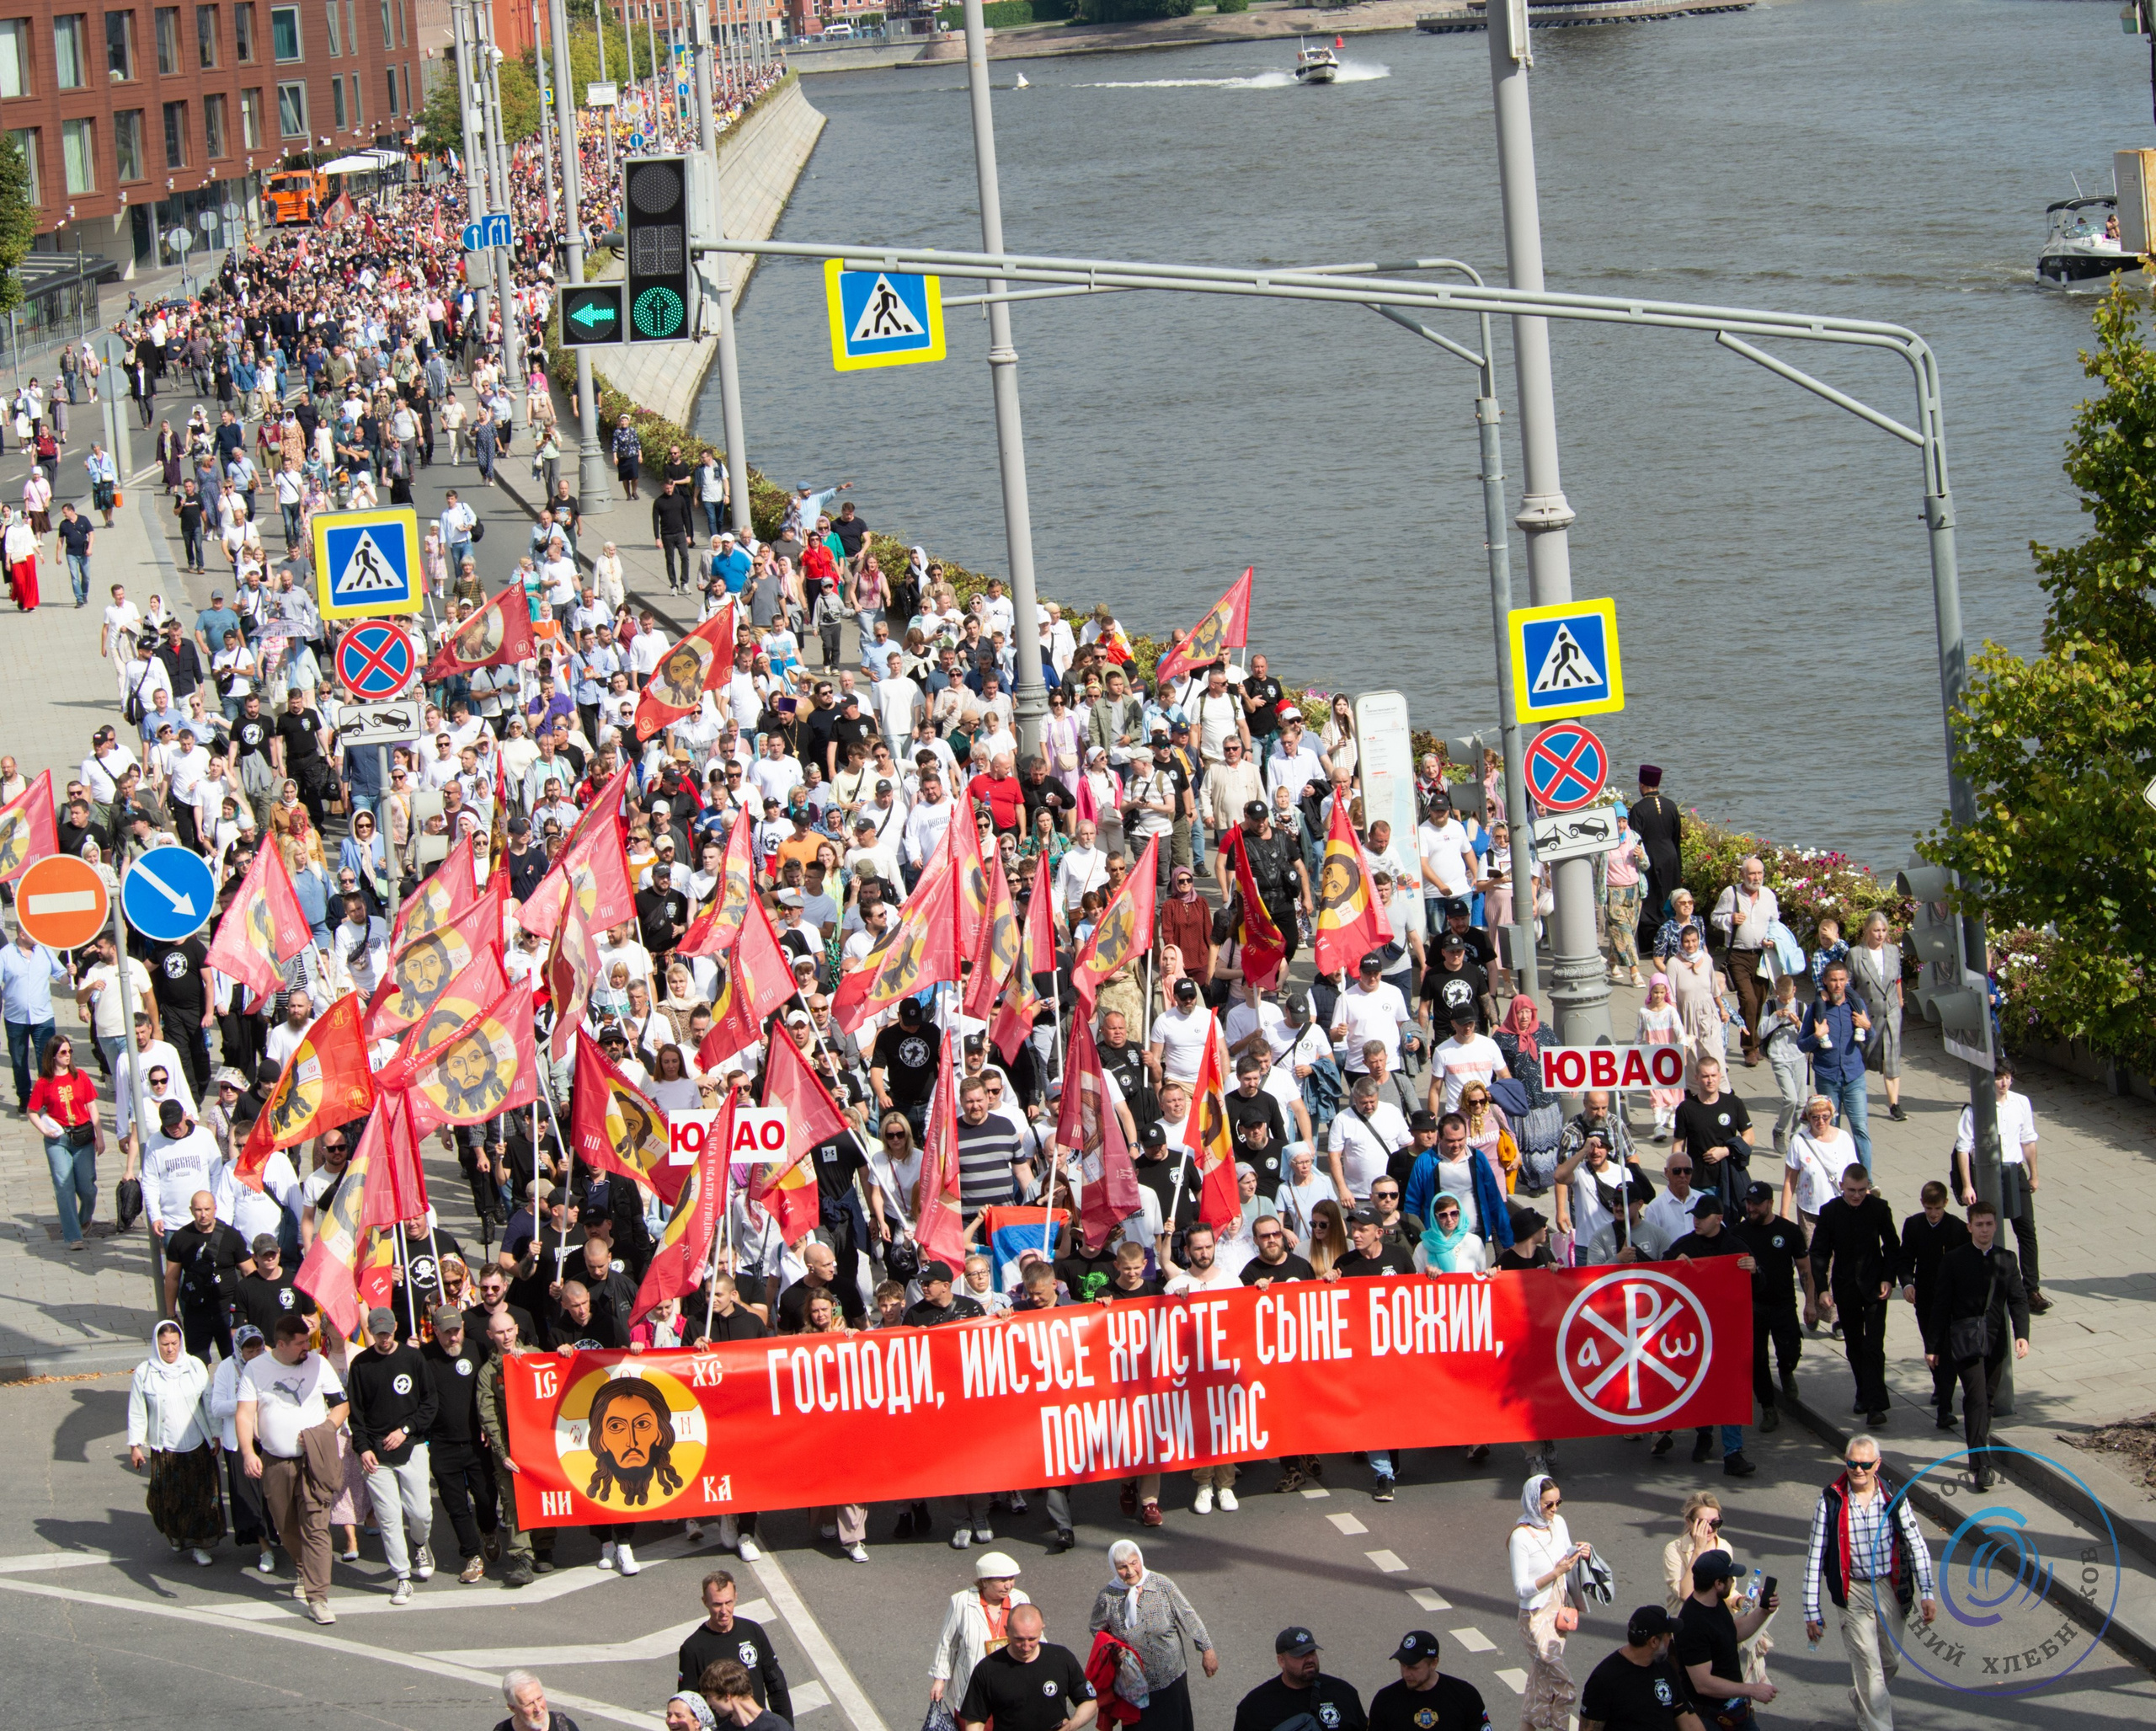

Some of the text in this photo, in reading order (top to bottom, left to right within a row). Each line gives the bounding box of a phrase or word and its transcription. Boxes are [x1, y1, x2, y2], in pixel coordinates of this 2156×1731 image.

[1542, 1047, 1683, 1088] ЮВАО
[670, 1119, 786, 1153] ЮАО
[766, 1272, 1504, 1416] ГОСПОДИ, ИИСУСЕ ХРИСТЕ, СЫНЕ БОЖИЙ,
[1039, 1376, 1269, 1477] ПОМИЛУЙ НАС
